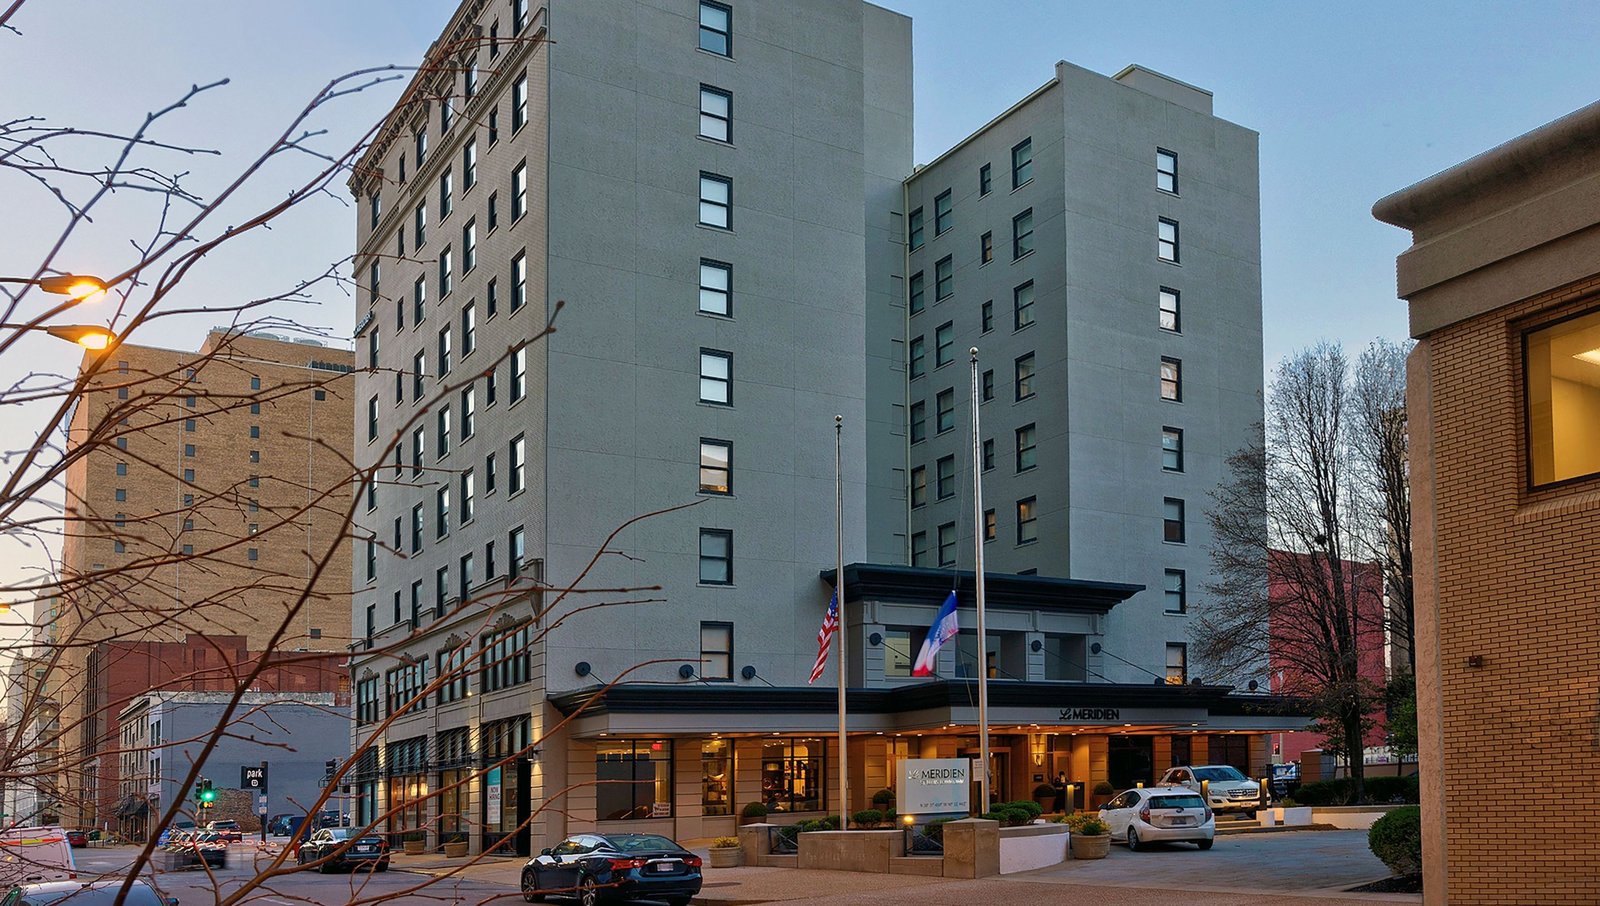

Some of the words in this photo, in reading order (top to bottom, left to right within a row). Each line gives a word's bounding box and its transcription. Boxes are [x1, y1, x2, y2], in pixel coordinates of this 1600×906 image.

[1072, 709, 1120, 720] MERIDIEN
[246, 769, 263, 779] park
[921, 768, 965, 779] MERIDIEN
